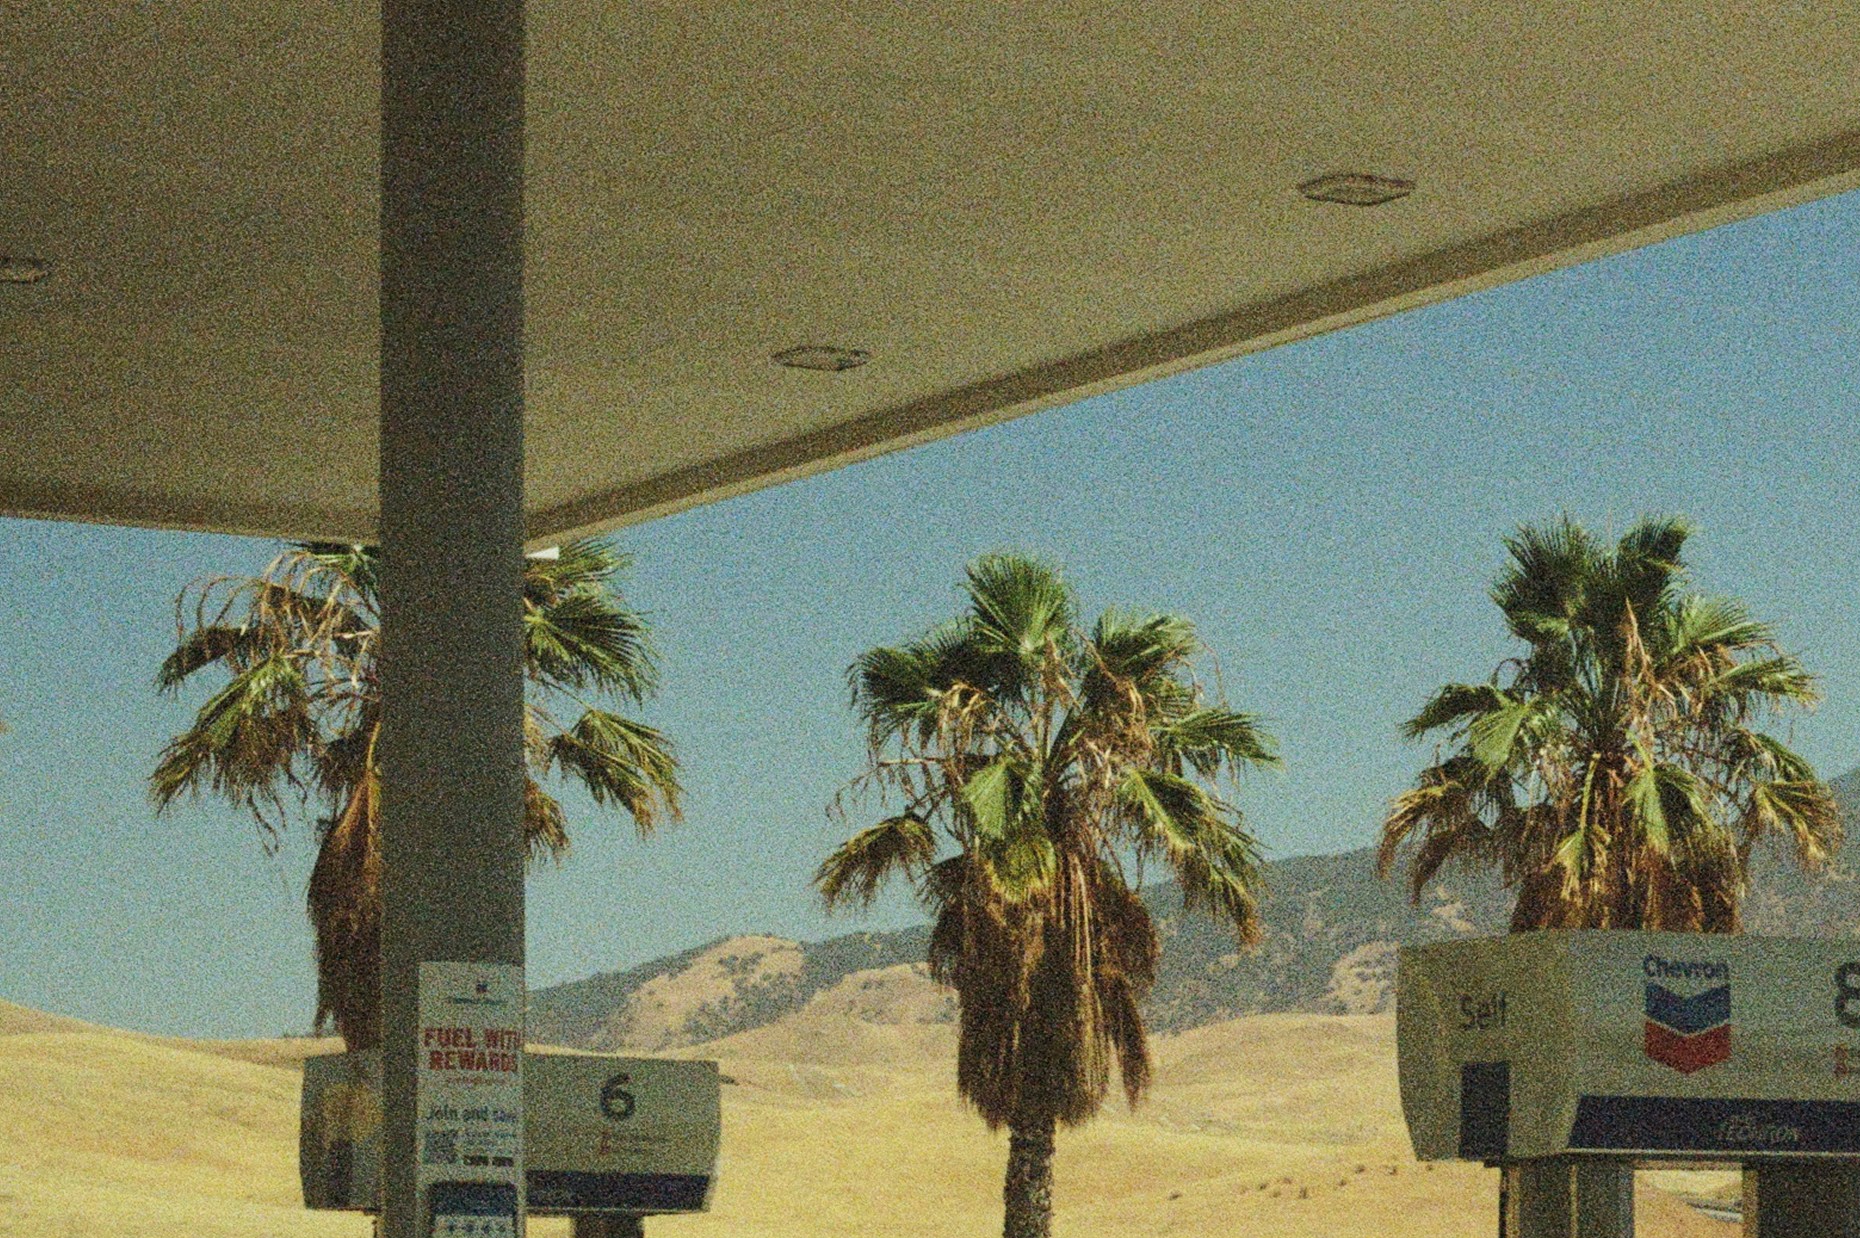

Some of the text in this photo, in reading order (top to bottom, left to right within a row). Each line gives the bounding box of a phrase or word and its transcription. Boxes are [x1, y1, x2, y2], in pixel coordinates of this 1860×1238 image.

[1643, 953, 1730, 982] Chevron
[424, 1027, 476, 1048] FUEL
[601, 1072, 635, 1121] 6
